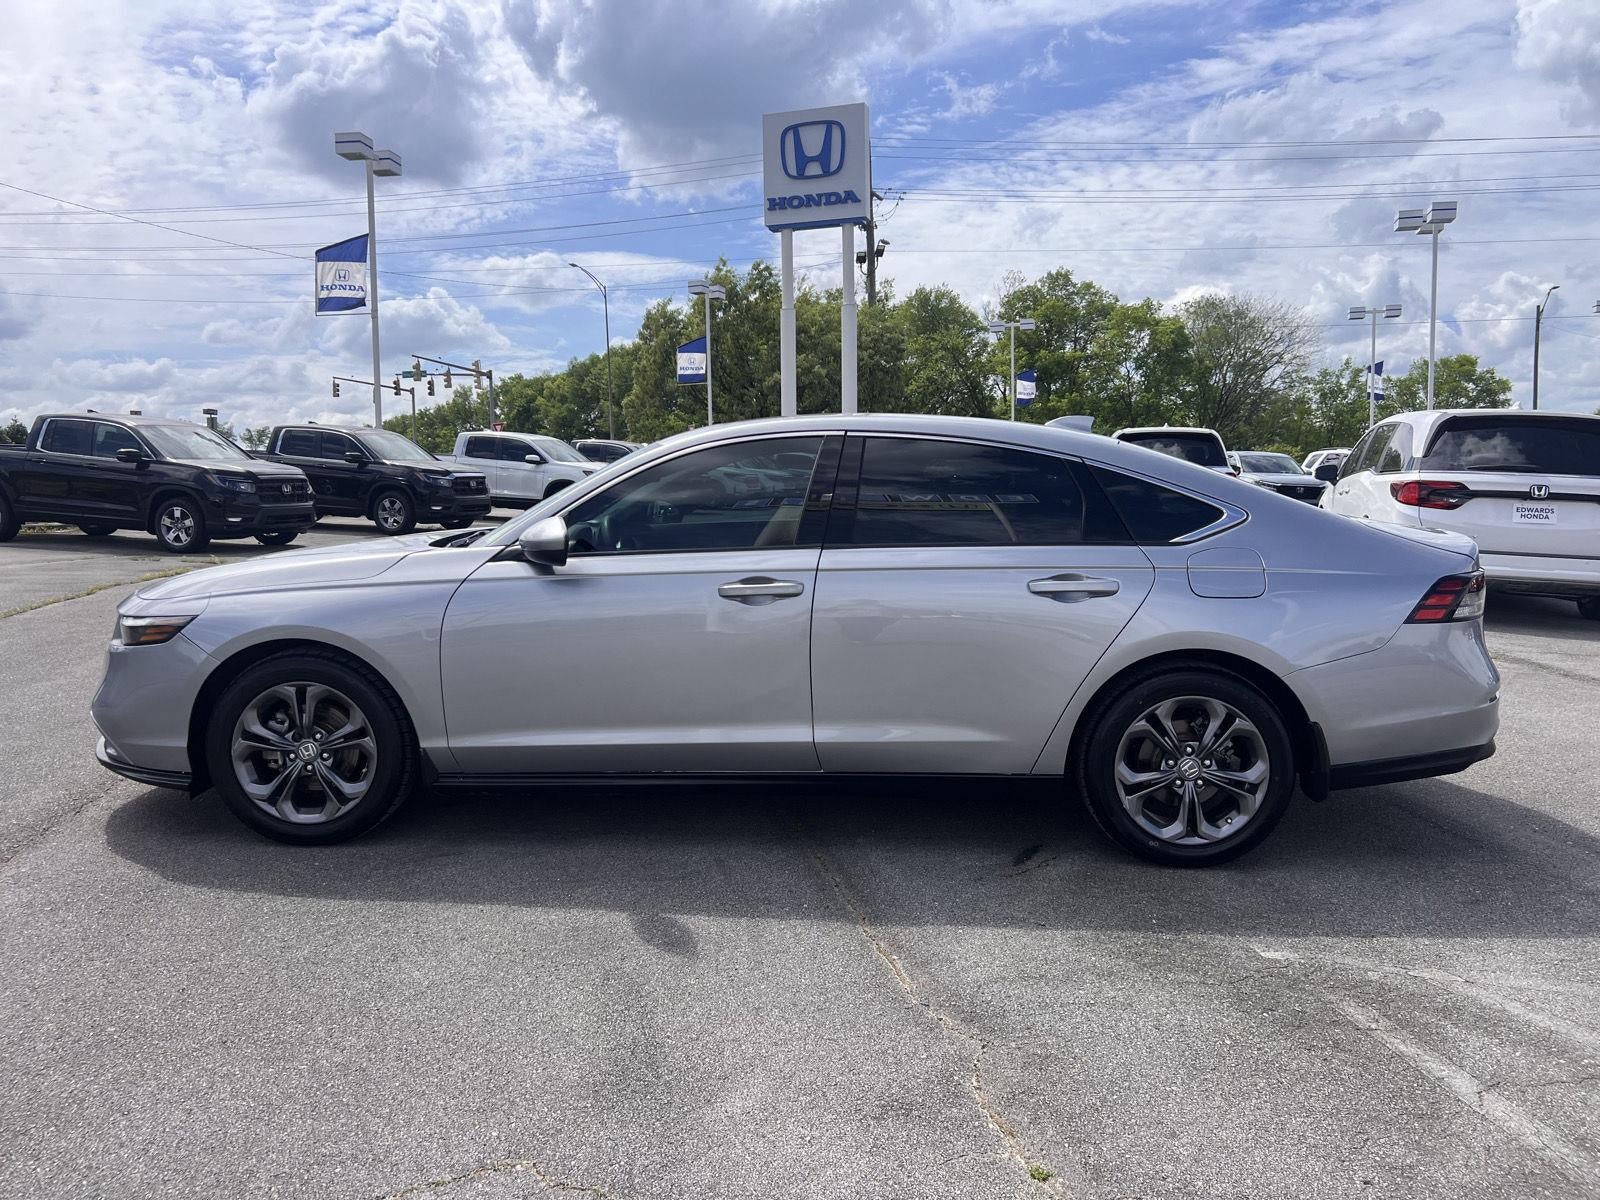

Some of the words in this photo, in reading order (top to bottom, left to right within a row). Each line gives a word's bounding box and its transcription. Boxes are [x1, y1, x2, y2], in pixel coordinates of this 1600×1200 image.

[767, 190, 862, 211] HONDA
[320, 284, 365, 292] HONDA
[1516, 506, 1555, 514] EDWARDS
